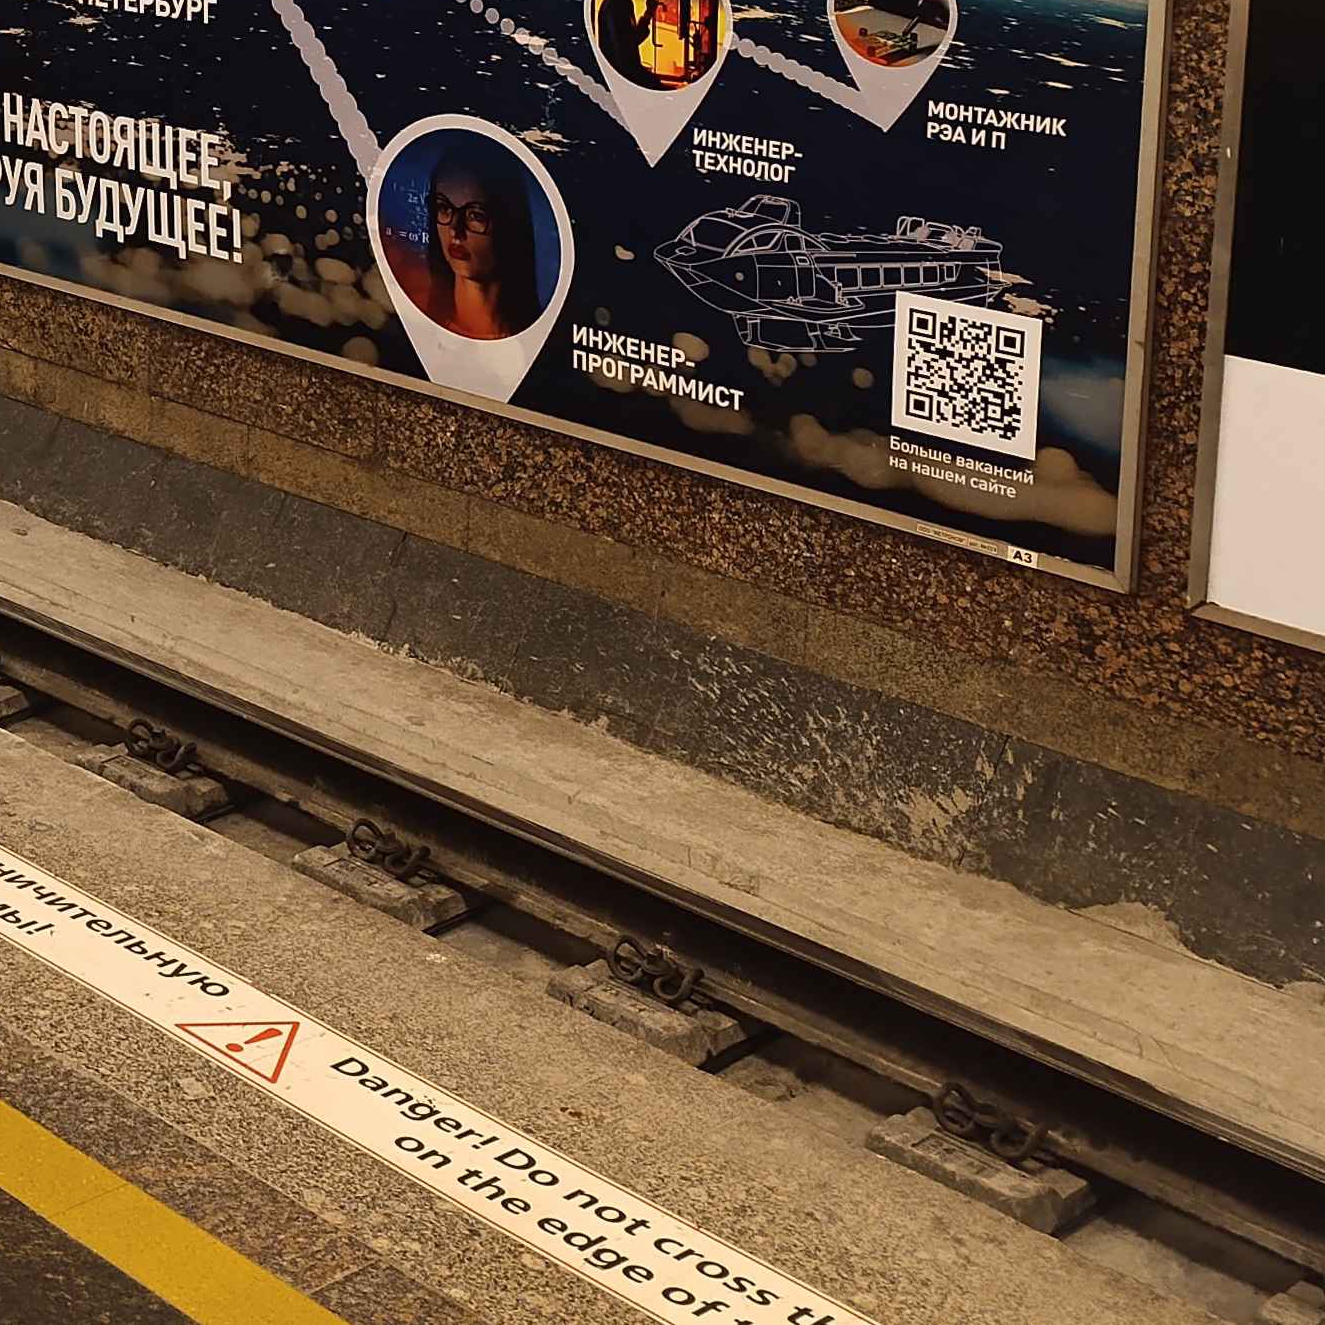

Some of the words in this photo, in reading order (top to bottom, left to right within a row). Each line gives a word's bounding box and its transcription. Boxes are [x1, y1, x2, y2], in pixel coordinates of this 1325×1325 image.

[926, 121, 967, 144] РЭА
[971, 128, 986, 147] И
[991, 131, 1006, 150] П
[928, 100, 1067, 137] МОНТАЖНИК
[3, 91, 232, 202] НАСТОЯЩЕЕ,
[692, 127, 804, 159] ИНЖЕНЕР-
[692, 149, 796, 184] ТЕХНОЛОГ
[55, 169, 243, 264] БУДУЩЕЕ!
[571, 324, 696, 369] ИНЖЕНЕР-
[571, 349, 744, 412] ПРОГРАММИСТ
[889, 435, 952, 463] Больше
[955, 455, 1034, 486] вакансий
[889, 455, 908, 470] на
[912, 461, 966, 486] нашем
[970, 477, 1017, 499] сайте
[329, 1055, 502, 1150] Danger!
[494, 1147, 560, 1187] Do
[563, 1188, 653, 1236] not
[653, 1237, 781, 1306] cross
[394, 1133, 452, 1170] on
[457, 1167, 531, 1216] the
[537, 1216, 655, 1285] edge
[661, 1286, 731, 1317] of
